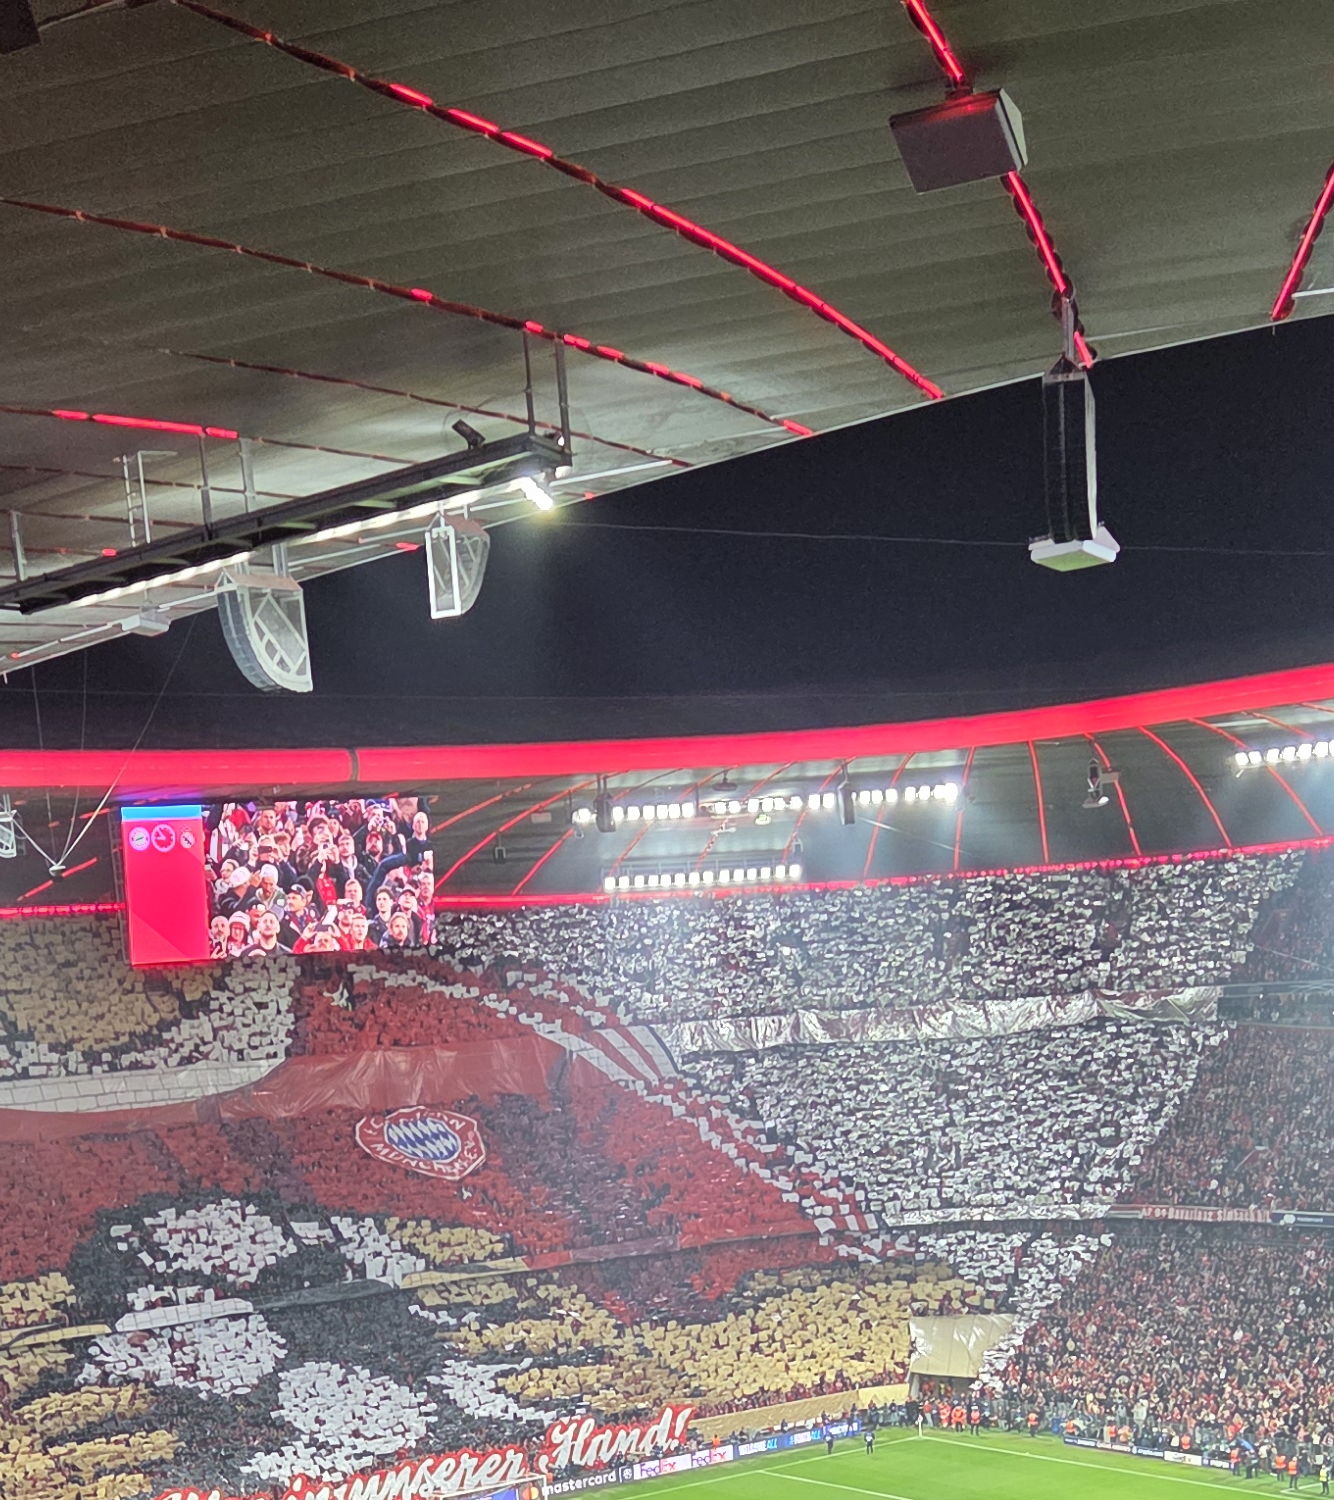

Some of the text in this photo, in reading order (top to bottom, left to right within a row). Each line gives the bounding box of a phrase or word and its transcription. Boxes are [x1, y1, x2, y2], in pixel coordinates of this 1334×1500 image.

[537, 1406, 694, 1474] Hand!
[639, 1459, 677, 1478] FedEx
[690, 1449, 727, 1467] FedEx
[542, 1472, 617, 1498] mastercard
